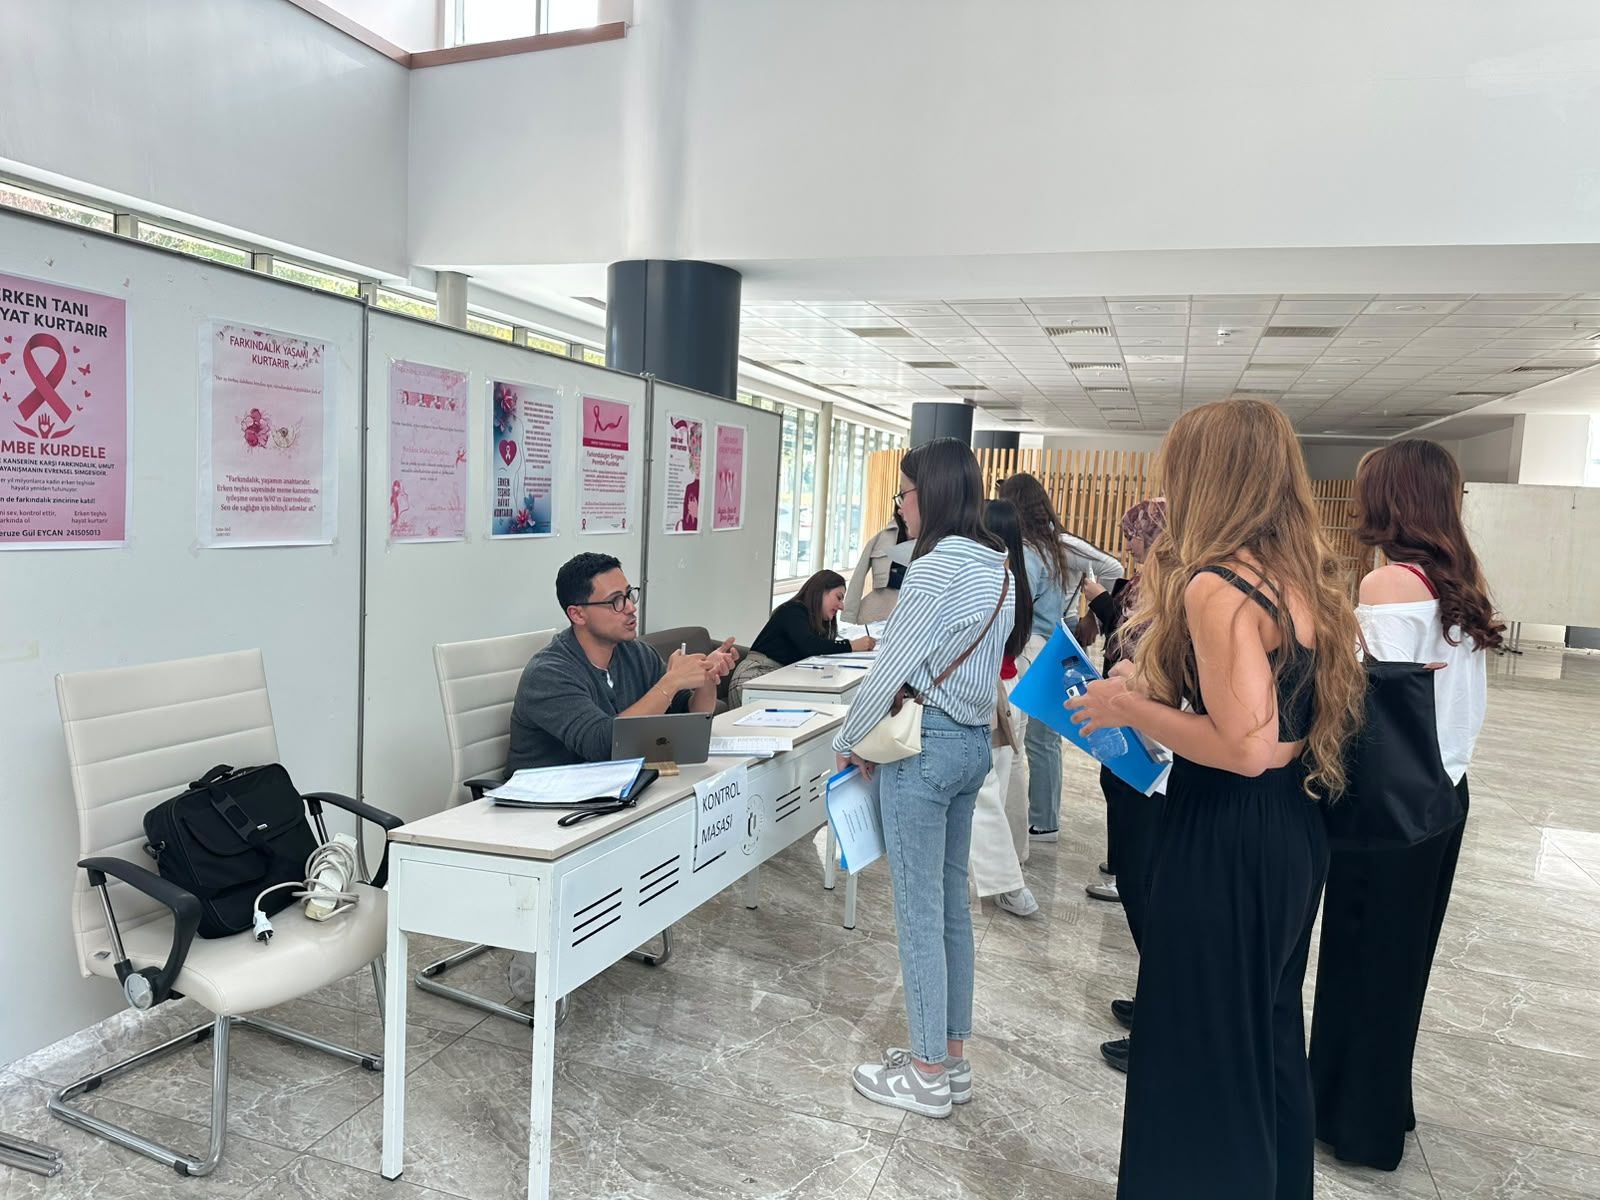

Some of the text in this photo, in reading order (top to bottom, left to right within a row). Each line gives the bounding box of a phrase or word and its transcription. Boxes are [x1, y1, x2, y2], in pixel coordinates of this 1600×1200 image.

[0, 287, 89, 317] RKEN TANI
[34, 313, 108, 338] KURTARIR
[229, 335, 281, 354] FARKINDALIK
[251, 354, 290, 370] KURTARIR
[40, 442, 106, 459] KURDELE
[44, 467, 73, 475] EVRENSEL
[37, 530, 64, 538] EYCAN
[702, 781, 741, 814] KONTROL
[701, 813, 734, 846] MASASI
